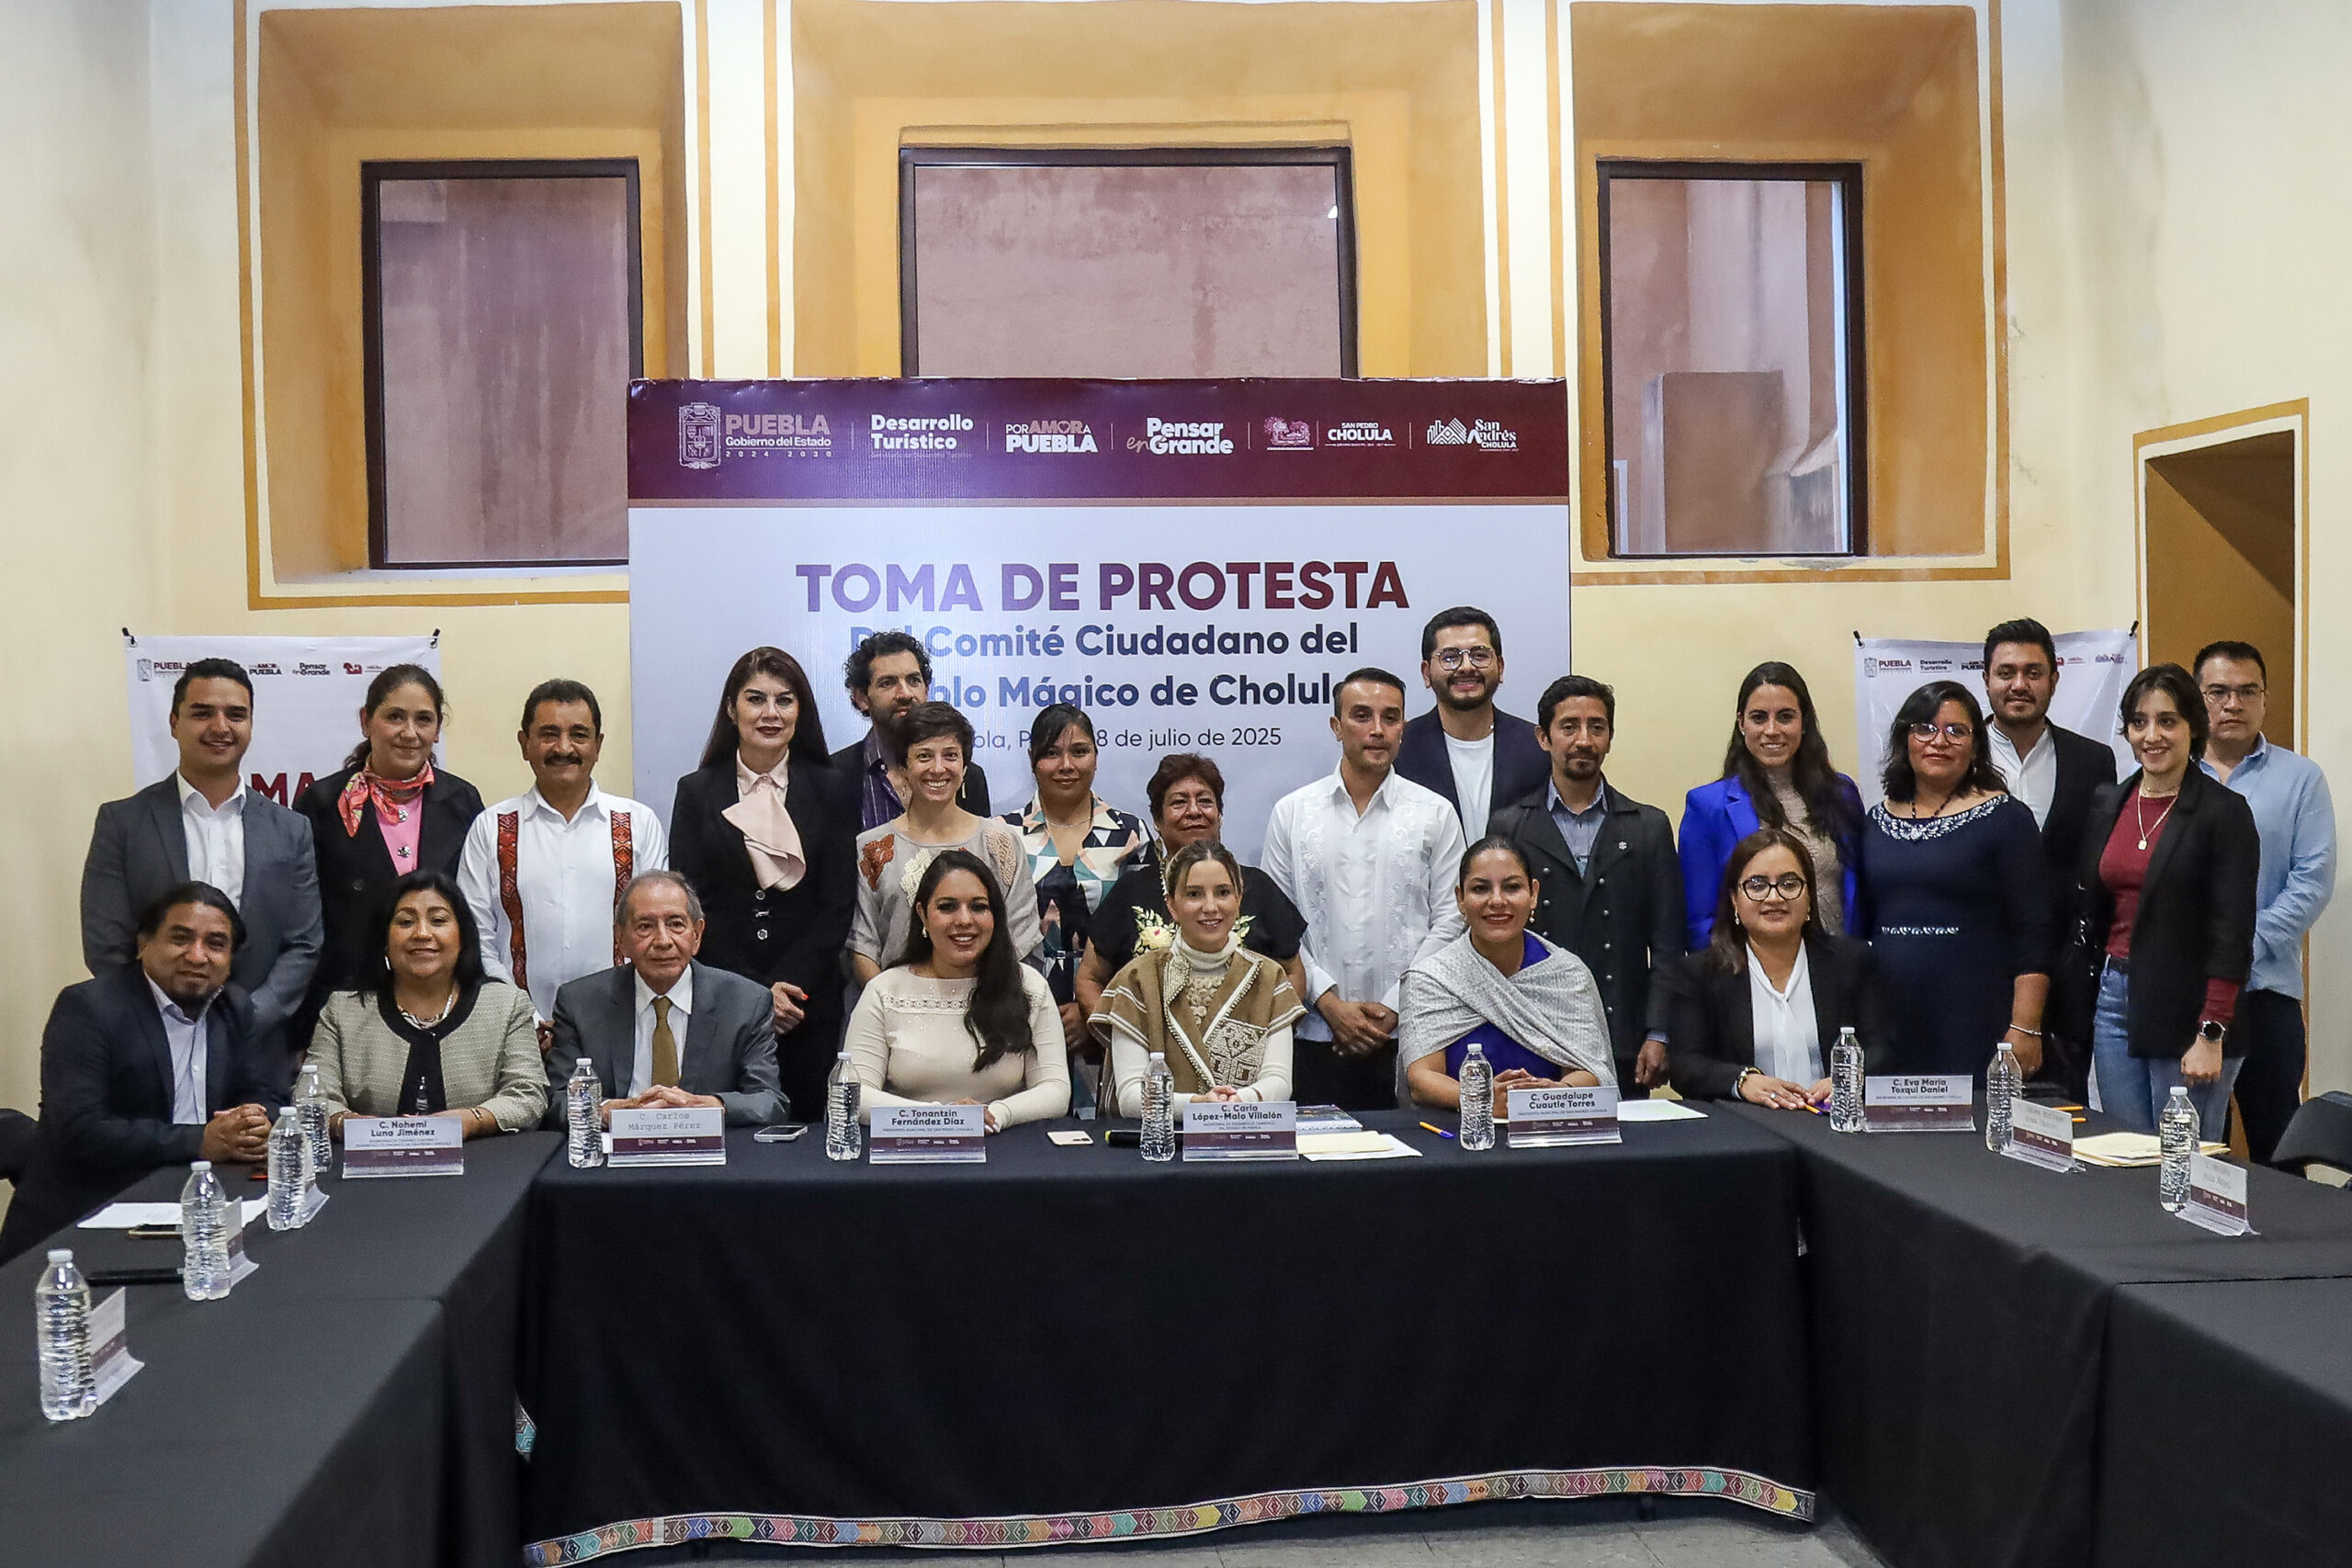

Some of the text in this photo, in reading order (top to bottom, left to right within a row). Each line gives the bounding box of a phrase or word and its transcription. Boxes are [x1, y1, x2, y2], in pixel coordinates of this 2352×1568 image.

[726, 414, 831, 434] PUEBLA
[871, 413, 974, 431] Desarrollo
[1147, 417, 1224, 437] Pensar
[1475, 418, 1500, 431] San
[726, 435, 831, 446] Gobierno del Estado
[871, 433, 957, 449] Turístico
[1328, 429, 1394, 441] CHOLULA
[1467, 429, 1517, 444] Andrés
[1006, 434, 1098, 453] PUEBLA
[1149, 434, 1235, 454] Grande
[797, 561, 1409, 613] TOMA DE PROTESTA
[925, 625, 1065, 658] Comité
[1076, 624, 1289, 656] Ciudadano
[1300, 622, 1358, 654] del
[1879, 660, 1911, 668] PUEBLA
[927, 672, 1330, 711] blo Mágico de Cholul
[972, 729, 1011, 751] bla,
[1096, 728, 1108, 747] 8
[1114, 728, 1142, 747] de
[1148, 728, 1192, 751] julio
[1198, 728, 1225, 746] de
[1231, 727, 1282, 746] 2025
[251, 773, 315, 807] MA
[1531, 1092, 1594, 1101] C. Guadalupe
[1891, 1086, 1918, 1095] Toxqui
[1221, 1104, 1230, 1112] C.
[1529, 1100, 1566, 1110] Cuautle
[899, 1109, 957, 1118] C. Tonantzin
[1193, 1111, 1283, 1122] López-Malo Villalón
[673, 1122, 701, 1130] Pérez
[891, 1116, 965, 1126] Fernández Díaz
[371, 1128, 435, 1137] Luna Jiménez
